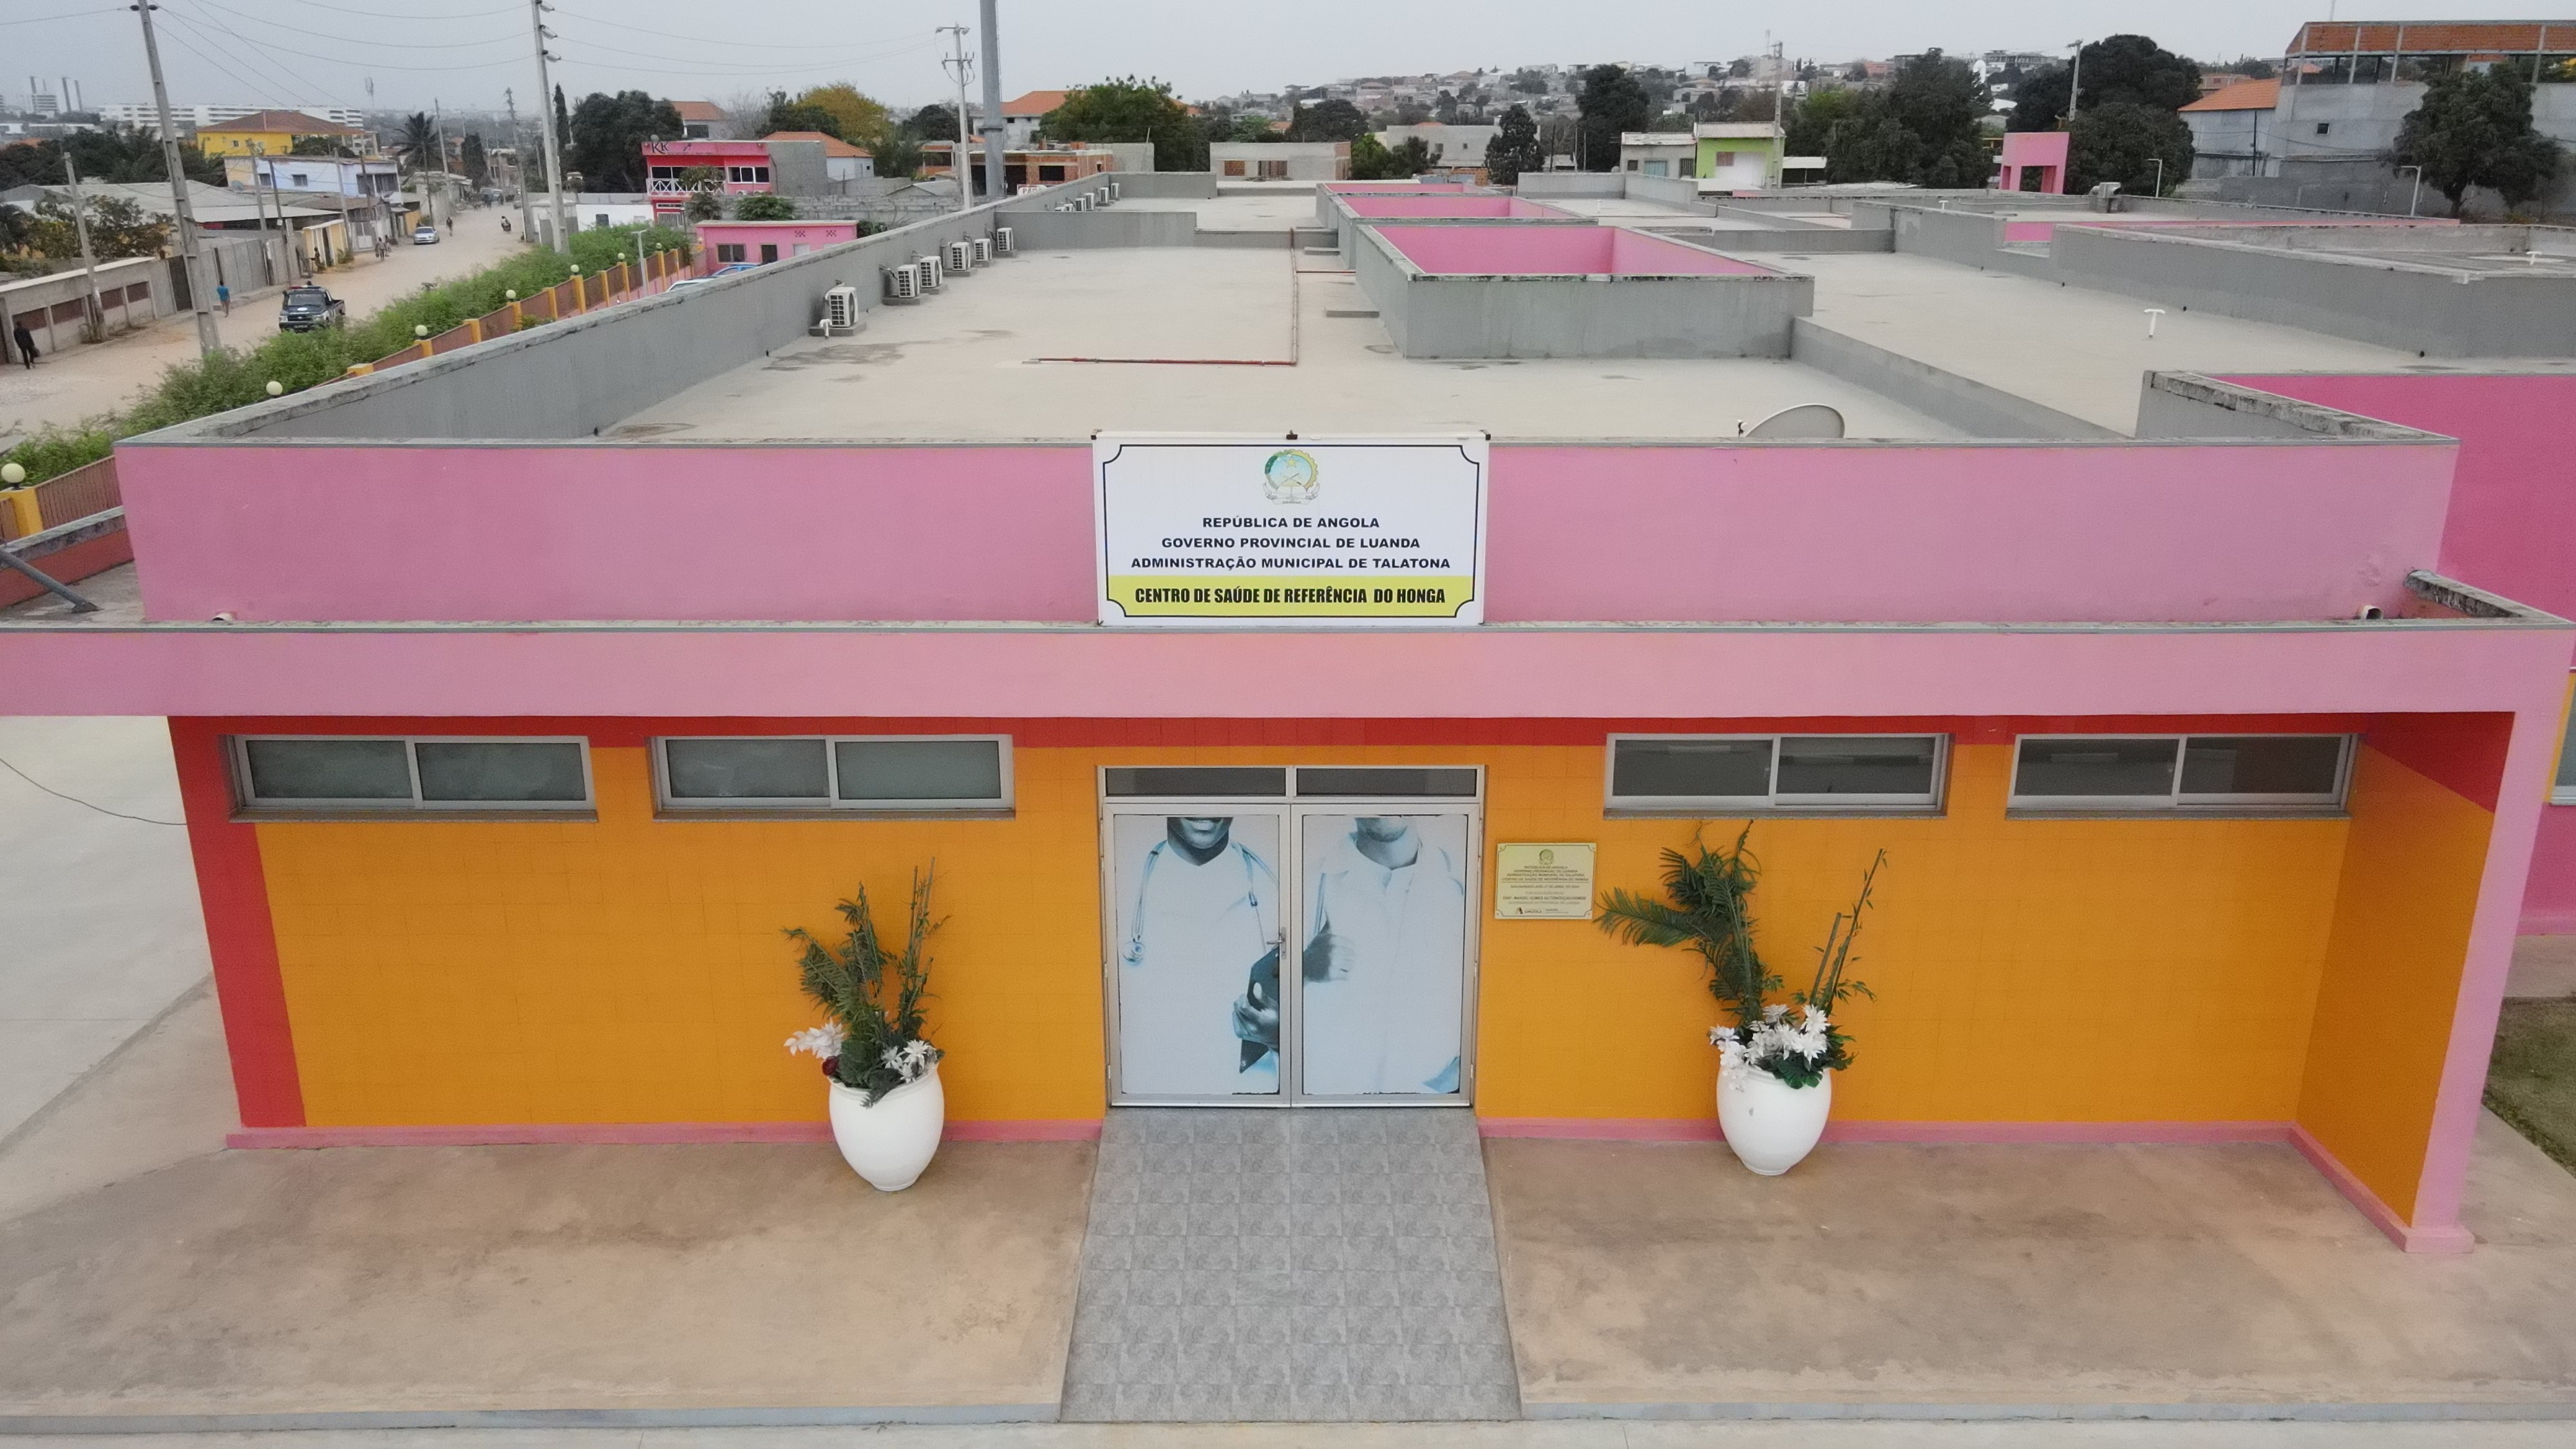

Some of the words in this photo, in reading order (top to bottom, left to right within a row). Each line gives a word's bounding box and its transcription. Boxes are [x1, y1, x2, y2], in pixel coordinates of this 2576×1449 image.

[1203, 516, 1288, 527] REPÚBLICA
[1293, 518, 1312, 527] DE
[1317, 518, 1379, 528] ANGOLA
[1162, 538, 1235, 548] GOVERNO
[1240, 538, 1331, 548] PROVINCIAL
[1336, 538, 1355, 548] DE
[1360, 538, 1420, 548] LUANDA
[1131, 556, 1256, 571] ADMINISTRAÇÃO
[1262, 558, 1343, 568] MUNICIPAL
[1349, 558, 1367, 568] DE
[1372, 558, 1450, 569] TALATONA
[1135, 588, 1190, 603] CENTRO
[1193, 588, 1211, 603] DE
[1214, 585, 1260, 603] SAÚDE
[1264, 588, 1281, 603] DE
[1284, 585, 1367, 603] REFERÊNCIA
[1374, 588, 1393, 603] DO
[1396, 588, 1445, 603] HONGA
